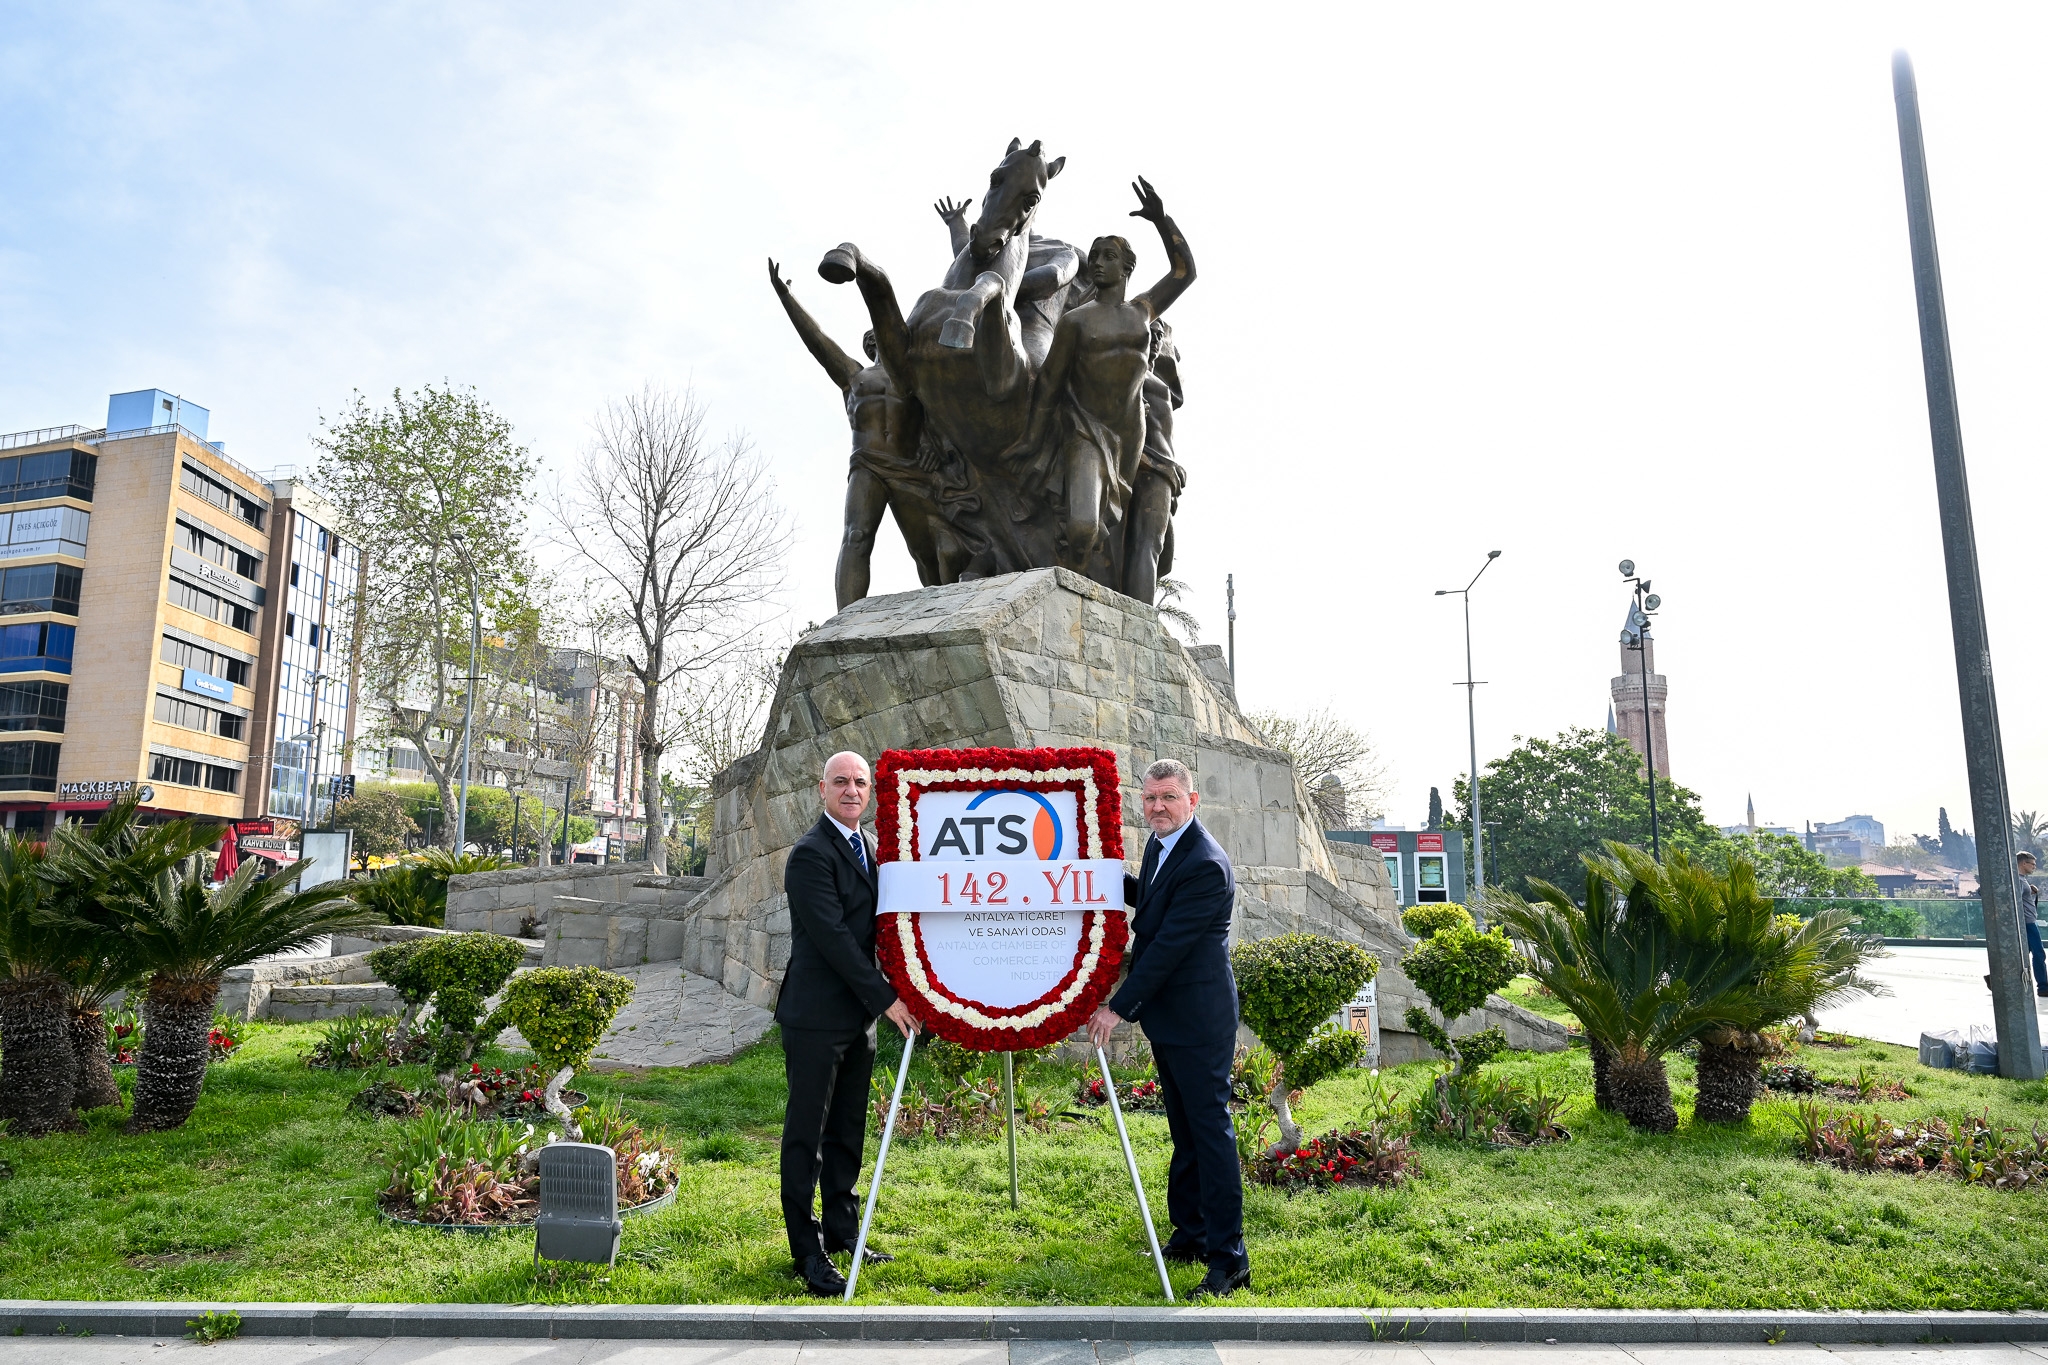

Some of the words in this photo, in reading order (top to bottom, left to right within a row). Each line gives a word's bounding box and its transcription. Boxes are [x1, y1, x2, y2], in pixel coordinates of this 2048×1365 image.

[17, 523, 31, 531] ENES
[61, 780, 131, 794] MACKBEAR
[75, 793, 102, 801] COFFEE
[242, 839, 264, 848] KAHVE
[1042, 863, 1108, 905] YIL
[964, 911, 1015, 922] ANTALYA
[1018, 910, 1066, 921] TİCARET
[968, 927, 984, 937] VE
[987, 925, 1029, 937] SANAYİ
[1031, 926, 1067, 936] ODASI
[936, 940, 988, 951] ANTALYA
[991, 940, 1048, 950] CHAMBER
[1050, 940, 1068, 950] OF
[973, 955, 1039, 966] COMMERCE
[1042, 955, 1068, 965] AND
[1365, 995, 1372, 1003] 20
